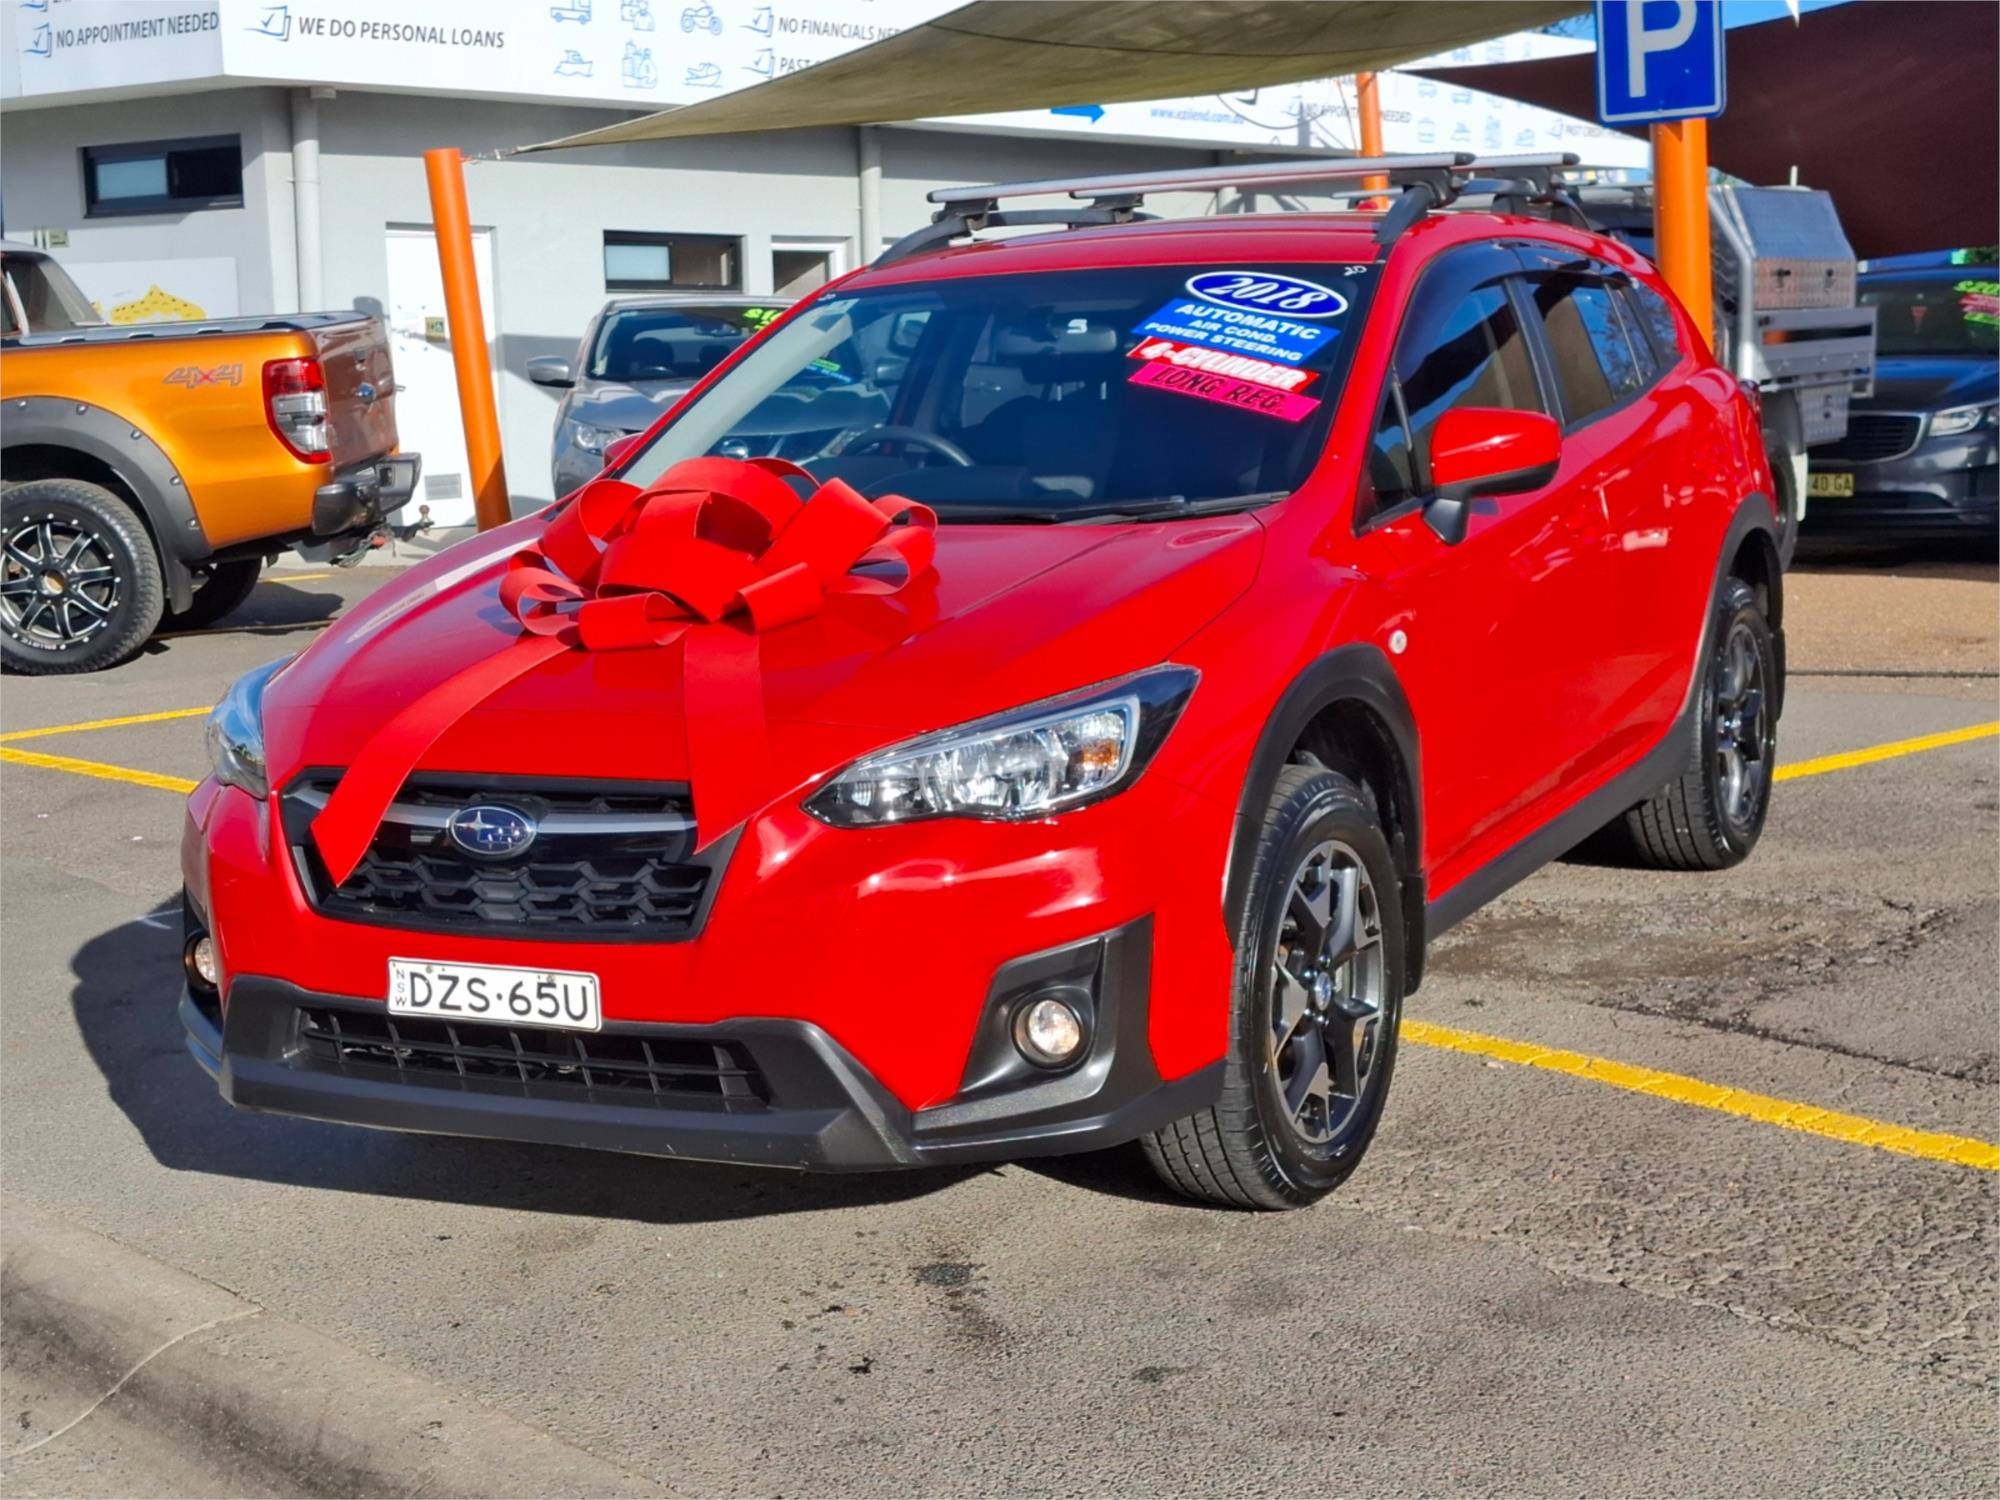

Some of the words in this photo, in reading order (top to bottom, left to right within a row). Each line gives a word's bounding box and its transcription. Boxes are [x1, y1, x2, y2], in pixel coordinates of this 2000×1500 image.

[56, 29, 76, 48] NO
[77, 18, 165, 46] APPOINTMENT
[167, 11, 220, 36] NEEDED
[299, 17, 326, 36] WE
[329, 19, 357, 38] DO
[360, 21, 448, 45] PERSONAL
[450, 28, 505, 49] LOANS
[779, 17, 798, 33] NO
[802, 20, 874, 40] FINANCIALS
[1626, 0, 1697, 98] P
[1203, 277, 1329, 310] 2018
[1174, 303, 1321, 340] AUTOMATIC
[1188, 319, 1222, 331] AIR
[1223, 326, 1278, 344] COND.
[1144, 322, 1209, 341] POWER
[1210, 334, 1304, 361] STEERING
[1140, 341, 1308, 391] 4-CYLINDER
[1151, 366, 1226, 395] LONG
